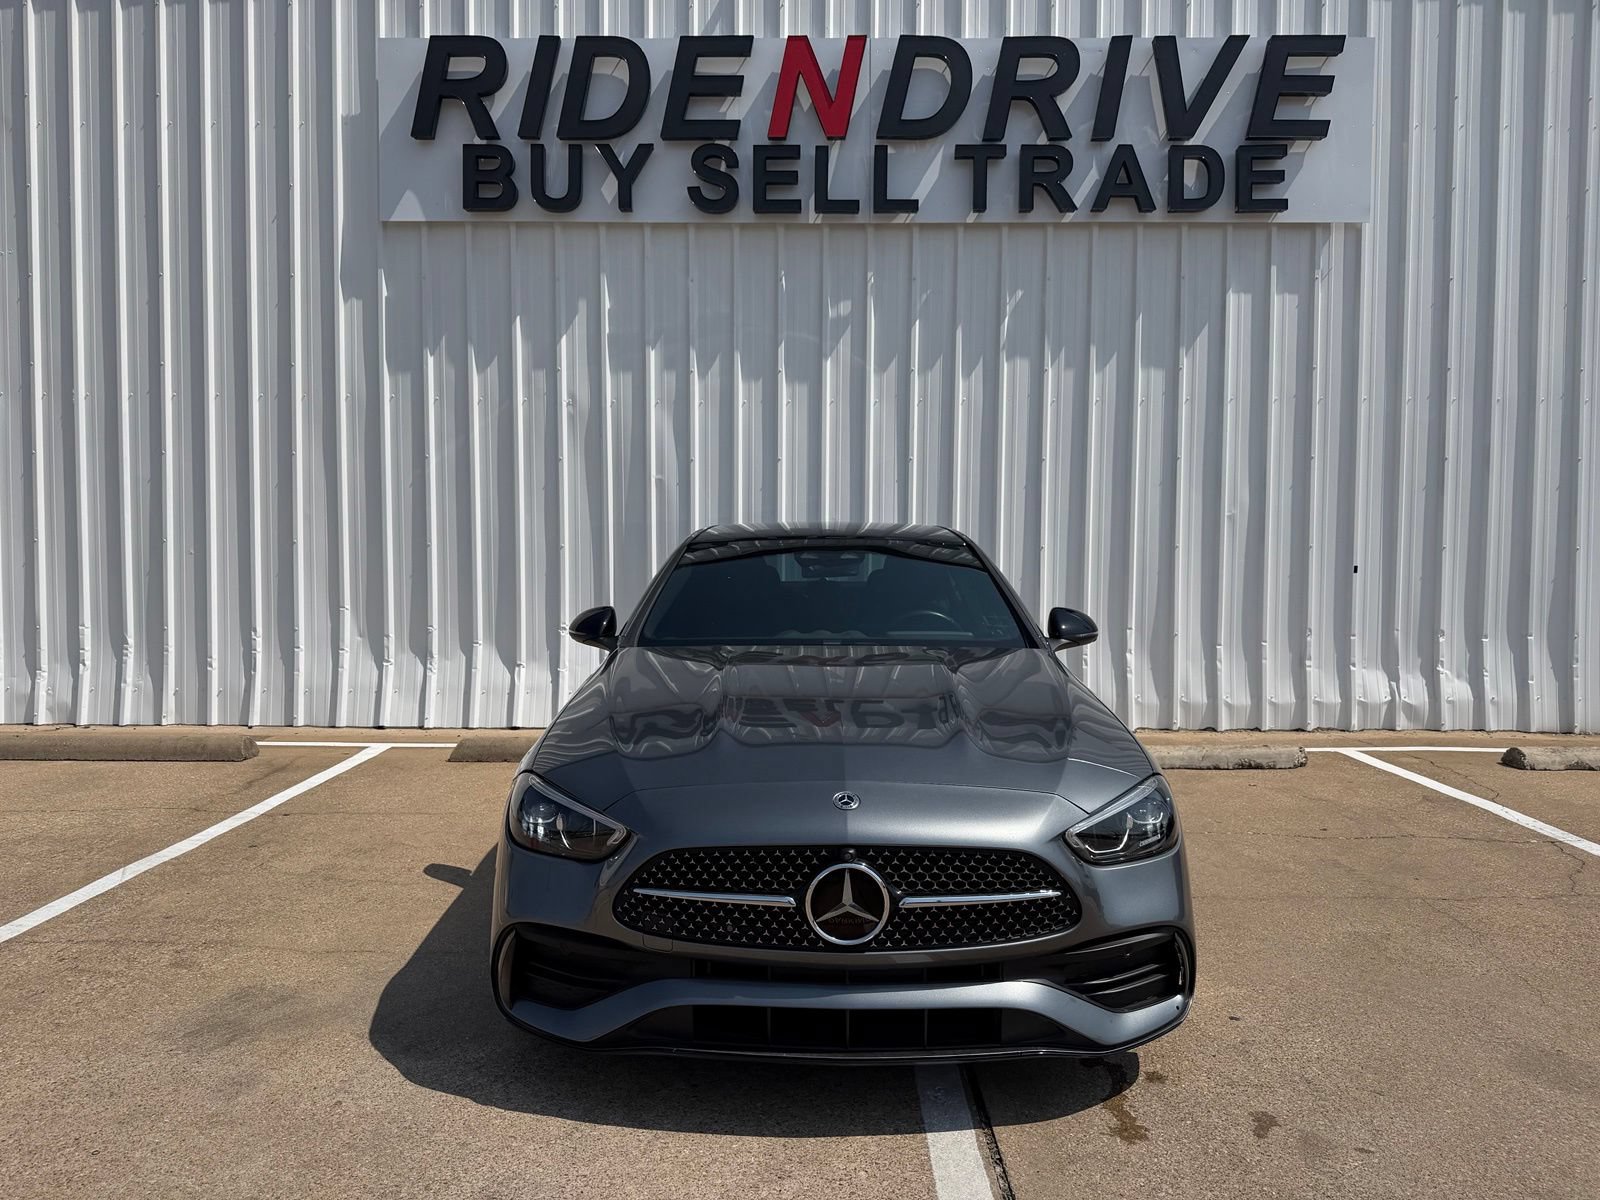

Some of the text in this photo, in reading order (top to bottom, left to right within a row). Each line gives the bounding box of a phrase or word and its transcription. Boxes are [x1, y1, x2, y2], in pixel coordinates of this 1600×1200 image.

[462, 143, 1289, 214] BUY SELL TRADE
